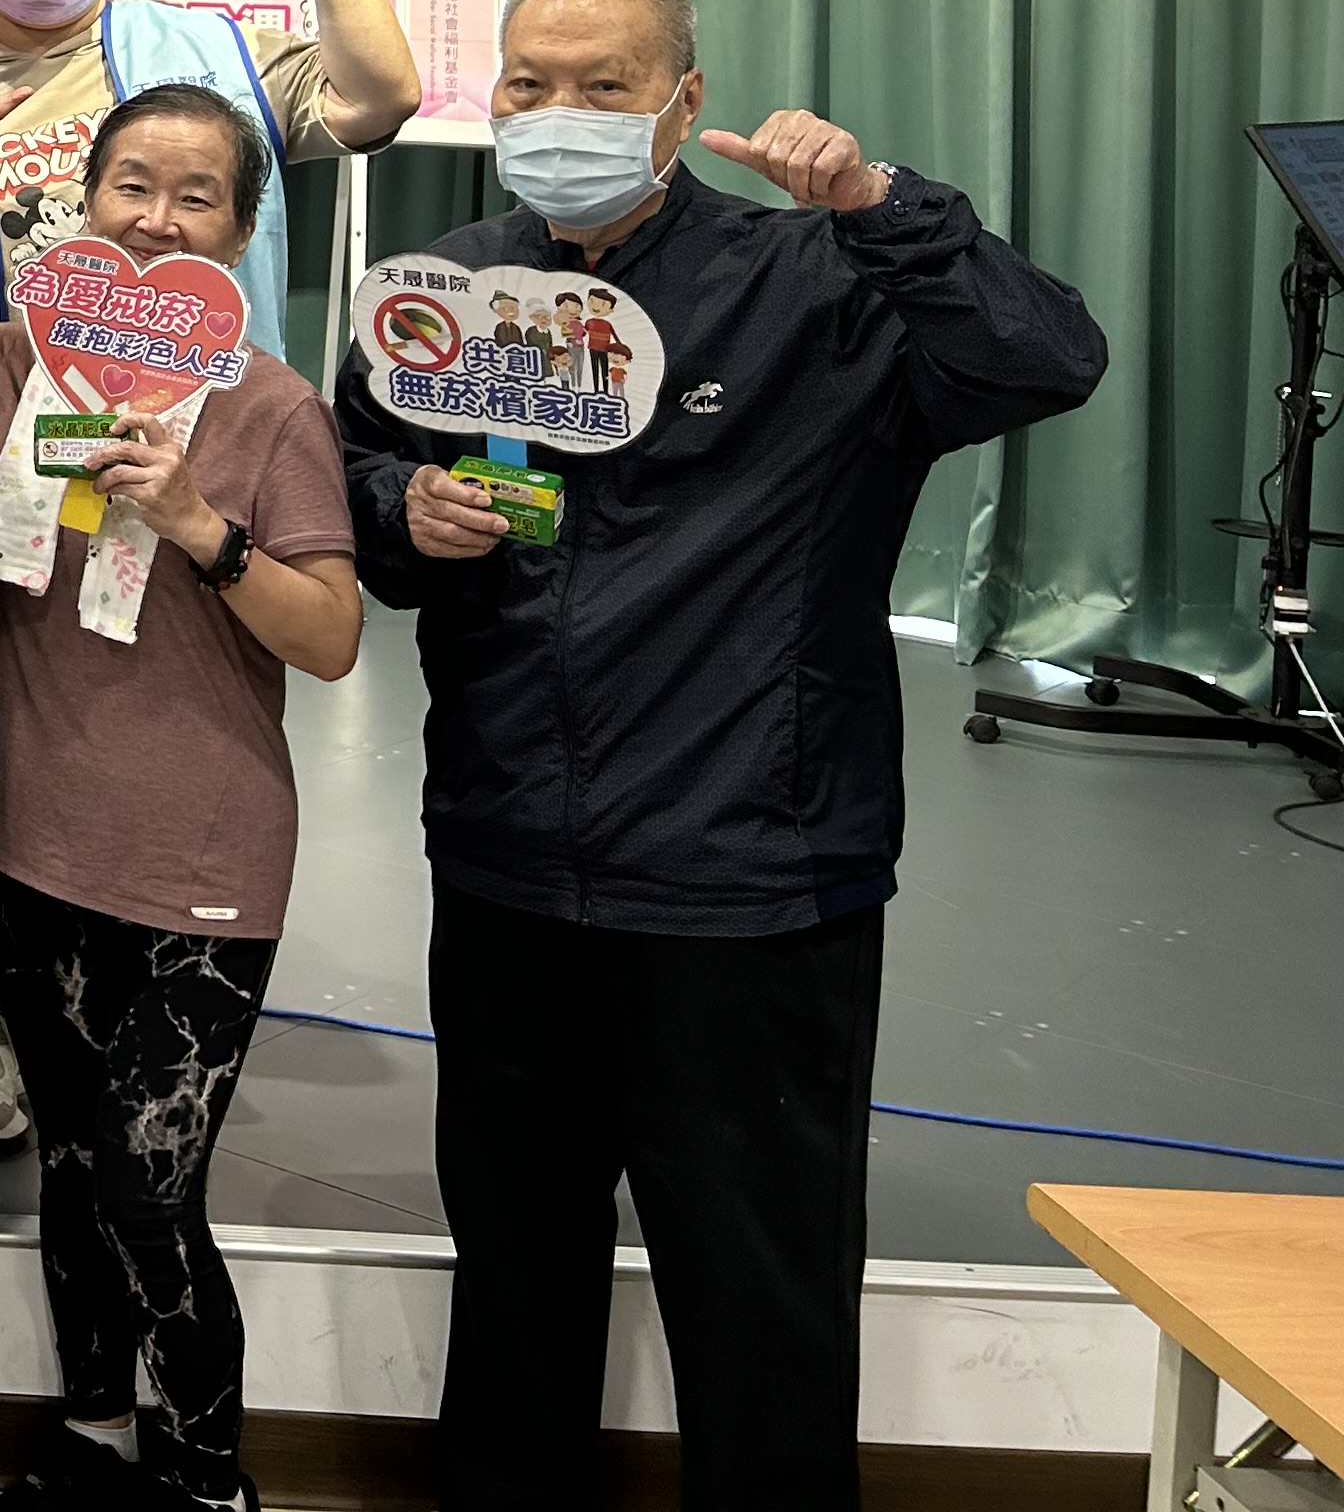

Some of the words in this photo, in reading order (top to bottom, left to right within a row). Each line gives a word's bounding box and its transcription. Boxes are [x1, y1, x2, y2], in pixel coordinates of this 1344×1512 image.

[57, 250, 120, 275] 天晟醫院
[378, 266, 472, 294] 天晟醫院
[11, 264, 206, 336] 為愛戒菸
[48, 318, 250, 389] 擁抱彩色人生
[462, 337, 544, 381] 共創
[389, 365, 632, 438] 無菸檳家庭
